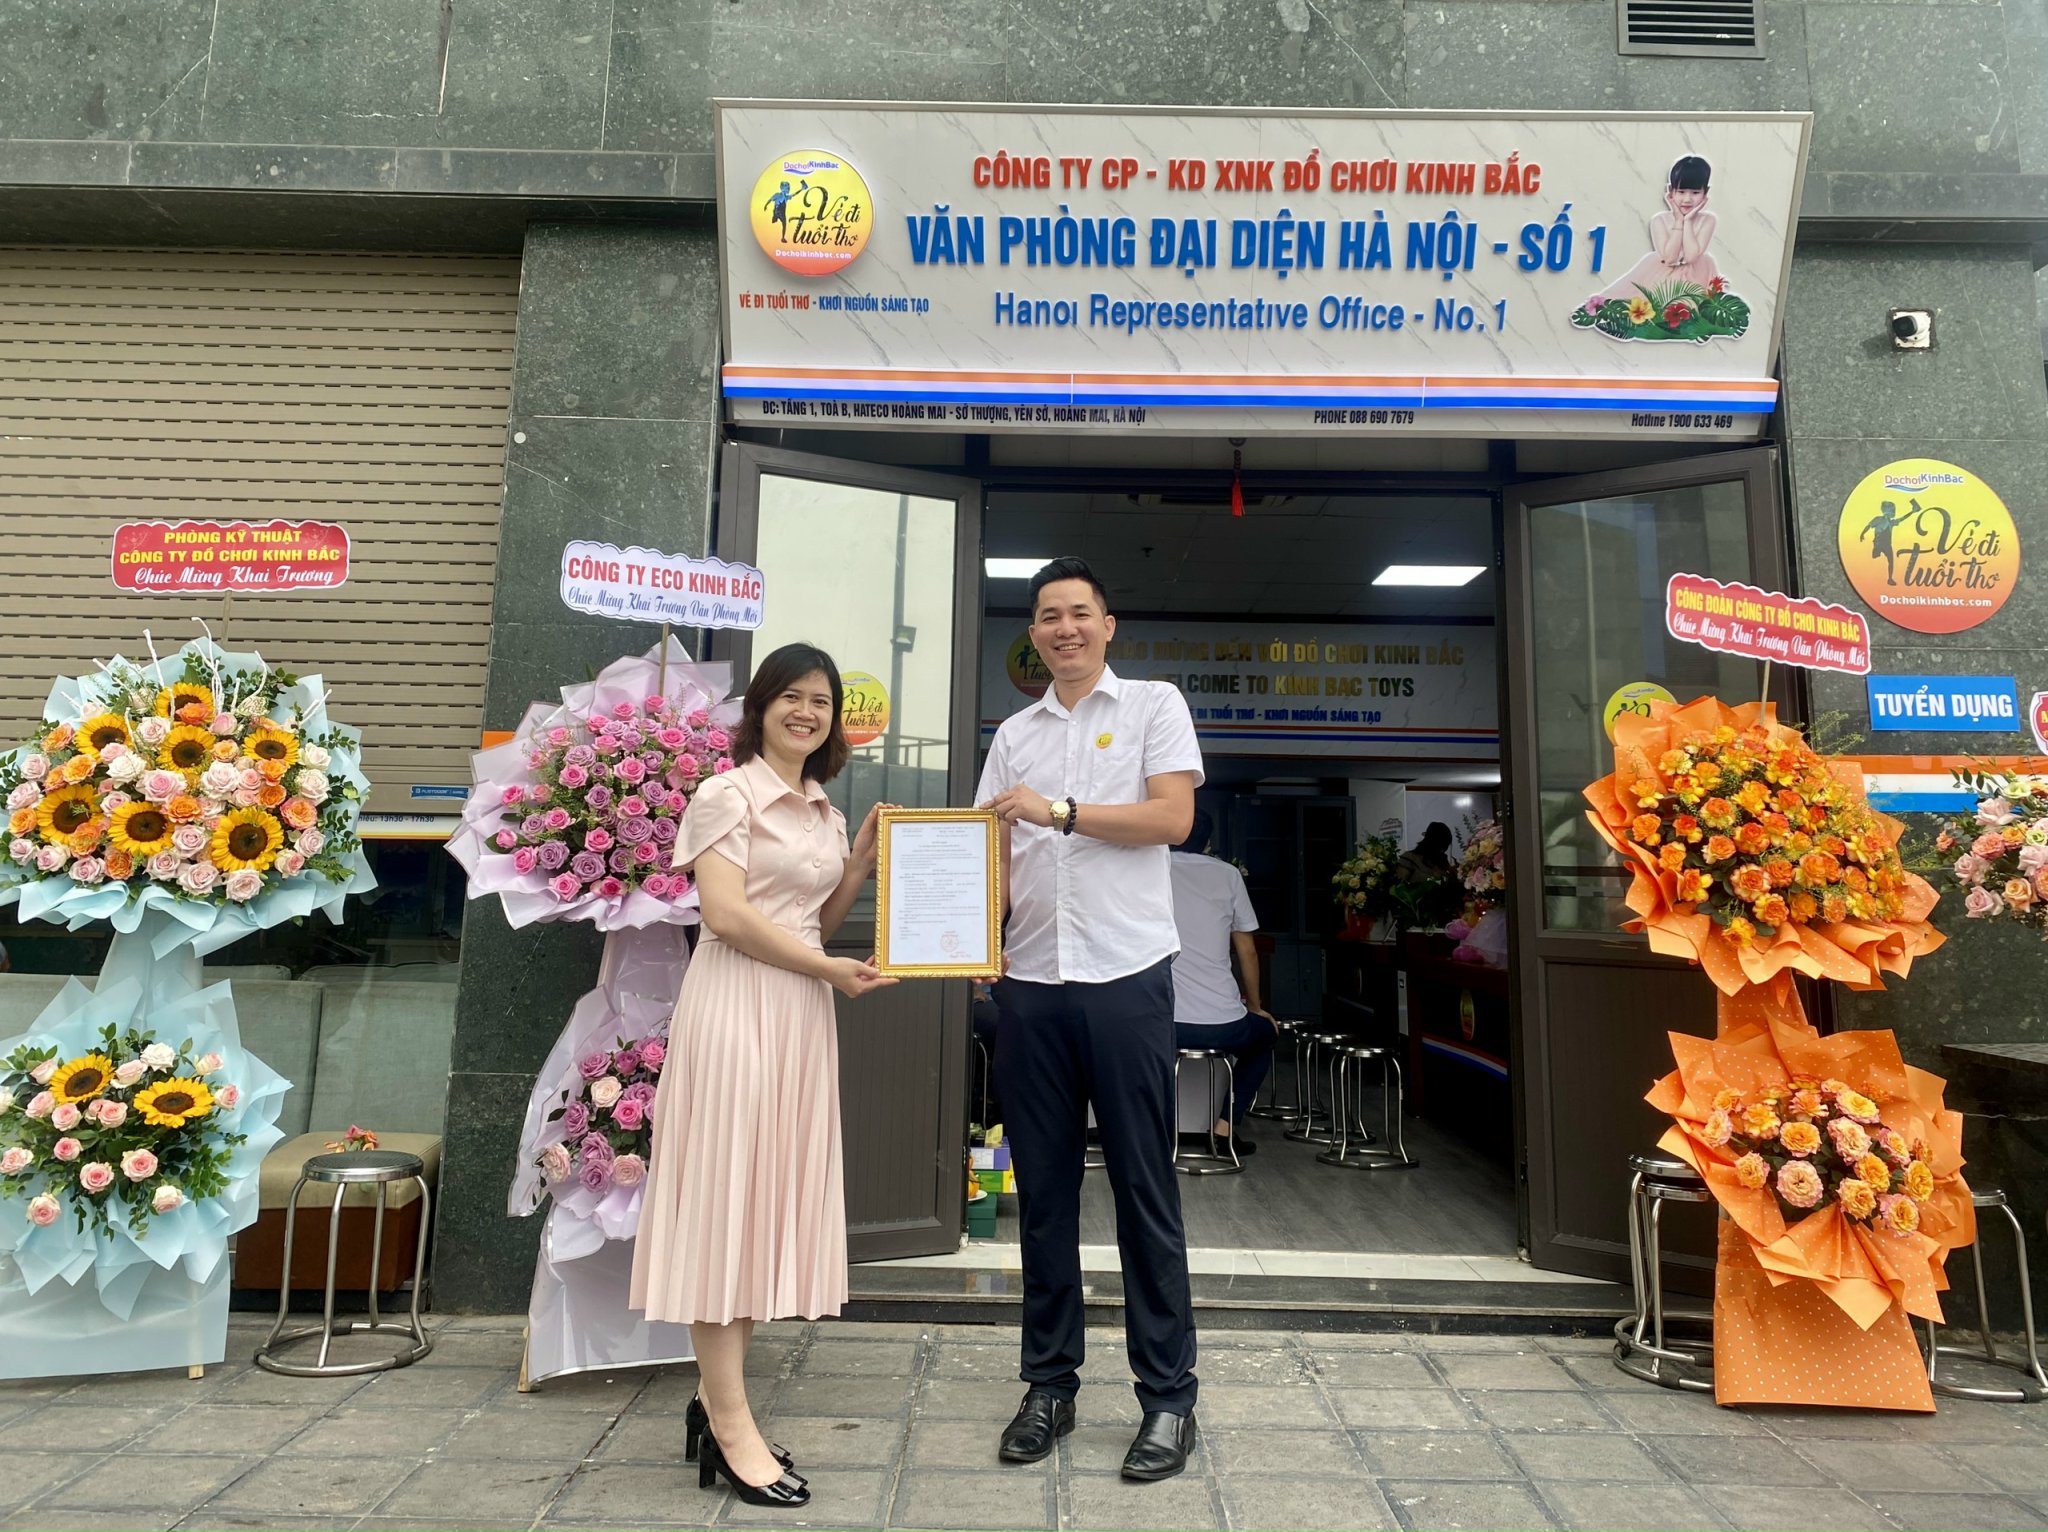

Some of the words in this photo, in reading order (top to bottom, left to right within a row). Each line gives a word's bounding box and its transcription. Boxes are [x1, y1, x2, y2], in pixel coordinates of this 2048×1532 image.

[973, 149, 1051, 188] CÔNG
[1059, 157, 1093, 189] TY
[1102, 158, 1139, 189] CP
[1147, 169, 1157, 178] -
[1168, 159, 1206, 191] KD
[1215, 160, 1275, 192] XNK
[1283, 147, 1321, 192] ĐỒ
[1330, 158, 1398, 193] CHƠI
[1405, 162, 1476, 194] KINH
[1484, 150, 1541, 194] BẮC
[906, 204, 985, 265] VĂN
[999, 204, 1136, 266] PHÒNG
[1150, 218, 1217, 278] ĐẠI
[1232, 207, 1325, 279] DIỆN
[1339, 209, 1392, 269] HÀ
[1406, 210, 1478, 280] NỘI
[1493, 242, 1509, 254] -
[1517, 202, 1574, 272] SỐ
[1588, 226, 1606, 273] 1
[753, 294, 764, 309] ĐI
[790, 294, 810, 310] THƠ
[818, 294, 842, 311] KHƠI
[910, 298, 929, 316] TẠO
[995, 291, 1078, 327] Hanoi
[1089, 293, 1308, 336] Representative
[1318, 295, 1405, 330] Office
[1414, 313, 1424, 321] -
[1495, 299, 1506, 331] 1
[810, 402, 818, 418] 1,
[842, 402, 851, 419] B,
[853, 403, 889, 419] HATECO
[891, 401, 925, 419] HOÀNG
[927, 405, 947, 420] MAI
[1053, 405, 1087, 423] HOÀNG
[1088, 408, 1110, 424] MAI,
[1113, 406, 1126, 423] HÀ
[1128, 406, 1146, 426] NỘI
[1314, 409, 1348, 424] PHONE
[1349, 410, 1368, 424] 088
[1370, 410, 1388, 424] 690
[1390, 410, 1414, 425] 7679
[1631, 412, 1666, 427] Hotline
[1668, 414, 1692, 428] 1900
[1693, 414, 1712, 428] 633
[1713, 414, 1733, 429] 469
[164, 529, 221, 544] PHÒNG
[225, 528, 247, 543] KỸ
[251, 529, 302, 545] THUẬT
[119, 548, 163, 564] CÔNG
[168, 550, 186, 562] TY
[219, 548, 259, 562] CHƠI
[262, 549, 302, 562] KINH
[307, 544, 341, 561] BẮC
[134, 566, 172, 584] Chúc
[175, 566, 223, 586] Mừng
[228, 565, 270, 583] Khai
[275, 565, 334, 585] Trương
[568, 555, 620, 584] CÔNG
[625, 563, 646, 586] TY
[651, 567, 684, 591] ECO
[689, 572, 727, 596] KINH
[731, 573, 761, 601] BẮC
[626, 592, 651, 612] Khai
[1880, 594, 1992, 608] Dochoikinhbac.com
[1675, 586, 1703, 612] CÔNG
[1705, 593, 1734, 617] ĐOÀN
[1735, 597, 1763, 622] CÔNG
[1764, 605, 1776, 625] TY
[1793, 611, 1815, 633] CHƠI
[1817, 616, 1840, 638] KINH
[1841, 616, 1860, 643] BẮC
[1728, 621, 1754, 645] Khai
[1106, 636, 1148, 661] HÀO
[1374, 644, 1420, 665] KINH
[1246, 675, 1268, 695] TO
[1325, 677, 1362, 697] BAC
[1368, 678, 1415, 698] TOYS
[1874, 684, 1946, 717] TUYỂN
[1951, 694, 2014, 722] DỤNG
